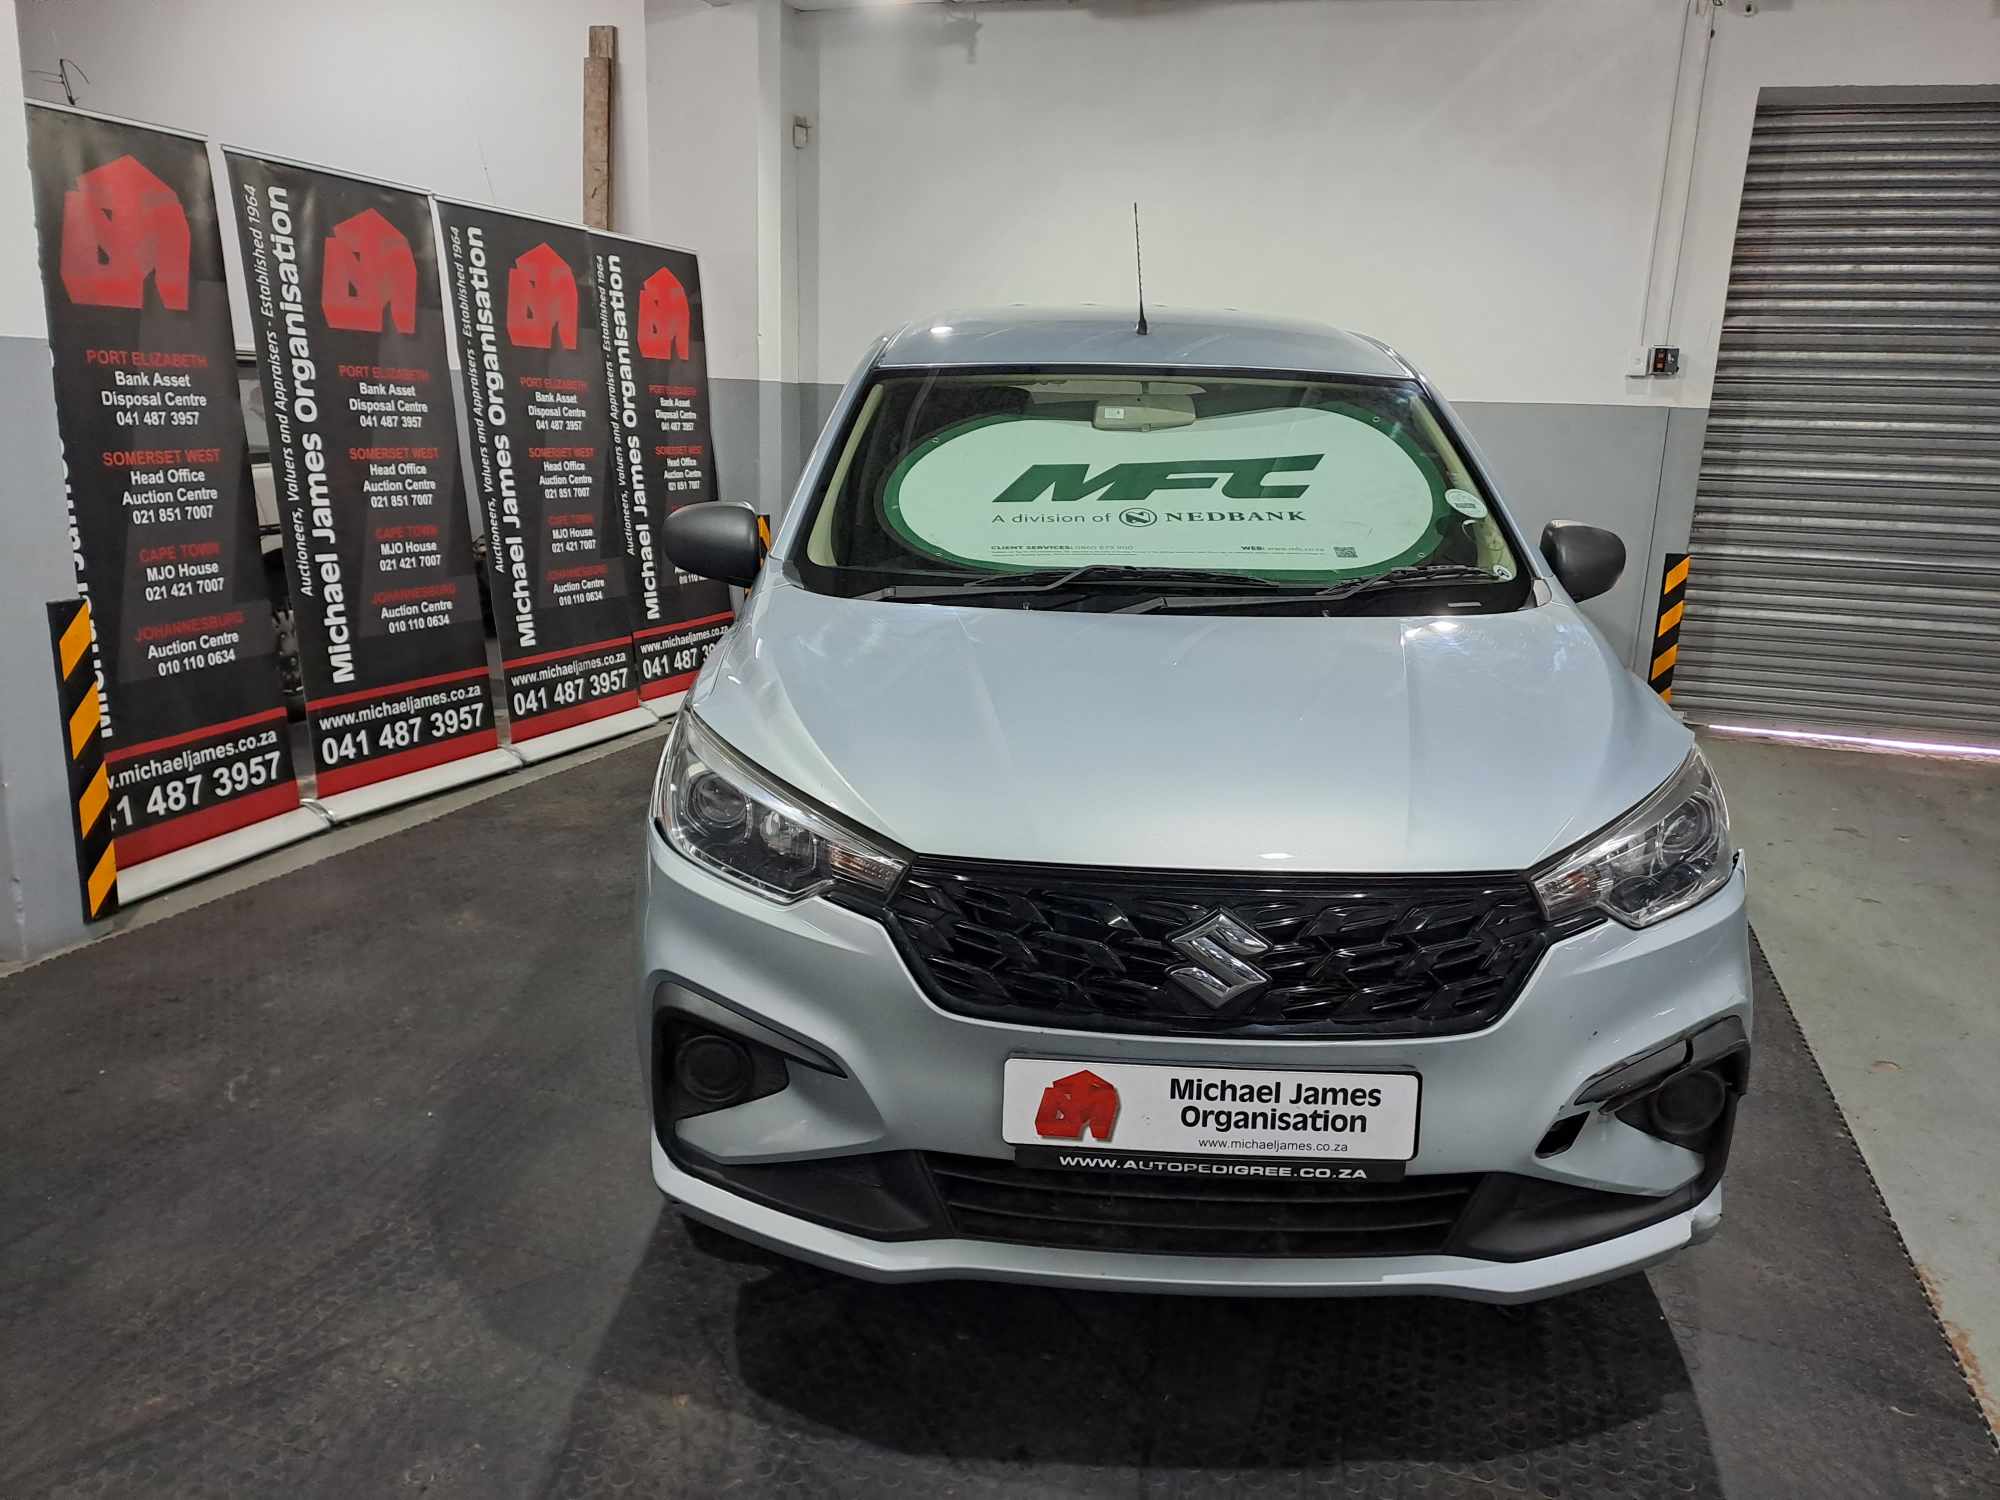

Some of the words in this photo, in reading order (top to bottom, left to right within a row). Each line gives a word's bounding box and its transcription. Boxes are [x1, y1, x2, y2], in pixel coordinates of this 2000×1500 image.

[244, 183, 259, 225] 1964
[450, 226, 463, 259] 1964
[249, 228, 274, 318] Established
[268, 185, 318, 423] Organisation
[455, 260, 473, 338] Established
[467, 226, 506, 426] Organisation
[597, 286, 611, 352] Established
[608, 255, 638, 428] Organisation
[86, 350, 128, 365] PORT
[131, 352, 208, 368] ELIZABETH
[266, 329, 288, 411] Appraisers
[115, 371, 150, 386] Bank
[153, 373, 191, 387] Asset
[359, 382, 386, 395] Bank
[388, 384, 416, 396] Asset
[467, 349, 482, 416] Appraisers
[605, 361, 619, 420] Appraisers
[102, 391, 161, 408] Disposal
[165, 392, 207, 406] Centre
[349, 398, 395, 413] Disposal
[397, 400, 428, 413] Centre
[535, 392, 554, 402] Bank
[116, 412, 139, 426] 041
[144, 412, 166, 425] 487
[171, 412, 200, 425] 3957
[360, 415, 378, 427] 041
[380, 416, 398, 427] 487
[402, 416, 422, 428] 3957
[528, 405, 561, 417] Disposal
[562, 407, 586, 417] Centre
[274, 412, 291, 443] and
[474, 417, 487, 442] and
[536, 420, 548, 430] 041
[551, 420, 563, 430] 487
[610, 420, 620, 444] and
[102, 450, 181, 466] SOMERSET
[185, 448, 220, 463] WEST
[370, 464, 396, 475] Head
[398, 463, 427, 475] Office
[479, 447, 494, 493] Valuers
[543, 461, 562, 471] Head
[563, 461, 585, 471] Office
[614, 446, 627, 486] Valuers
[130, 470, 164, 485] Head
[167, 468, 205, 483] Office
[285, 447, 300, 501] Valuers
[363, 480, 403, 492] Auction
[405, 478, 436, 490] Centre
[494, 435, 520, 529] James
[539, 475, 567, 485] Auction
[568, 475, 592, 484] Centre
[628, 435, 648, 517] James
[992, 453, 1325, 503] MFC
[122, 490, 173, 506] Auction
[177, 487, 218, 501] Centre
[302, 433, 336, 544] James
[371, 496, 388, 508] 021
[391, 494, 409, 506] 851
[411, 493, 433, 505] 7007
[545, 488, 557, 498] 021
[132, 509, 155, 524] 021
[159, 508, 181, 522] 851
[185, 505, 214, 520] 7007
[621, 490, 635, 556] Auctioneers,
[992, 514, 1005, 524] A
[1011, 513, 1085, 524] division
[1096, 512, 1112, 524] of
[1166, 511, 1307, 523] NEDBANK
[488, 497, 504, 573] Auctioneers,
[552, 528, 568, 539] MJO
[570, 528, 593, 538] House
[552, 542, 564, 553] 021
[566, 541, 578, 552] 421
[139, 545, 176, 562] CAPE
[293, 507, 312, 597] Auctioneers,
[380, 542, 403, 555] MJO
[405, 541, 437, 553] House
[146, 565, 175, 582] MJO
[178, 562, 219, 578] House
[380, 559, 397, 571] 021
[400, 557, 416, 569] 421
[419, 554, 441, 567] 7007
[635, 523, 660, 620] Michael
[145, 586, 167, 601] 021
[171, 583, 192, 597] 421
[197, 577, 224, 593] 7007
[505, 536, 536, 647] Michael
[553, 582, 580, 594] Auction
[581, 579, 605, 590] Centre
[315, 553, 355, 684] Michael
[381, 605, 419, 619] Auction
[421, 600, 453, 613] Centre
[389, 621, 406, 634] 010
[408, 618, 424, 631] 110
[427, 614, 450, 627] 0634
[148, 639, 196, 659] Auction
[200, 632, 239, 647] Centre
[640, 625, 728, 654] www.michaeljames.co.za
[158, 659, 180, 676] 010
[183, 655, 205, 670] 110
[208, 649, 236, 665] 0634
[511, 651, 626, 687] www.michaeljames.co.za
[643, 655, 669, 679] 041
[674, 648, 697, 670] 487
[514, 687, 548, 716] 041
[554, 679, 584, 705] 487
[590, 668, 628, 696] 3957
[319, 685, 481, 730] www.michaeljames.co.za
[322, 729, 369, 765] 041
[379, 716, 422, 749] 487
[430, 703, 484, 737] 3957
[146, 775, 202, 816] 487
[213, 751, 280, 796] 3957
[1169, 1077, 1281, 1104] Michael
[1289, 1080, 1382, 1108] James
[1180, 1105, 1367, 1134] Organisation
[1198, 1137, 1348, 1153] www.michaeljames.co.za
[1059, 1155, 1368, 1179] WWW.AUTOPEDIGREE.CO.ZA
